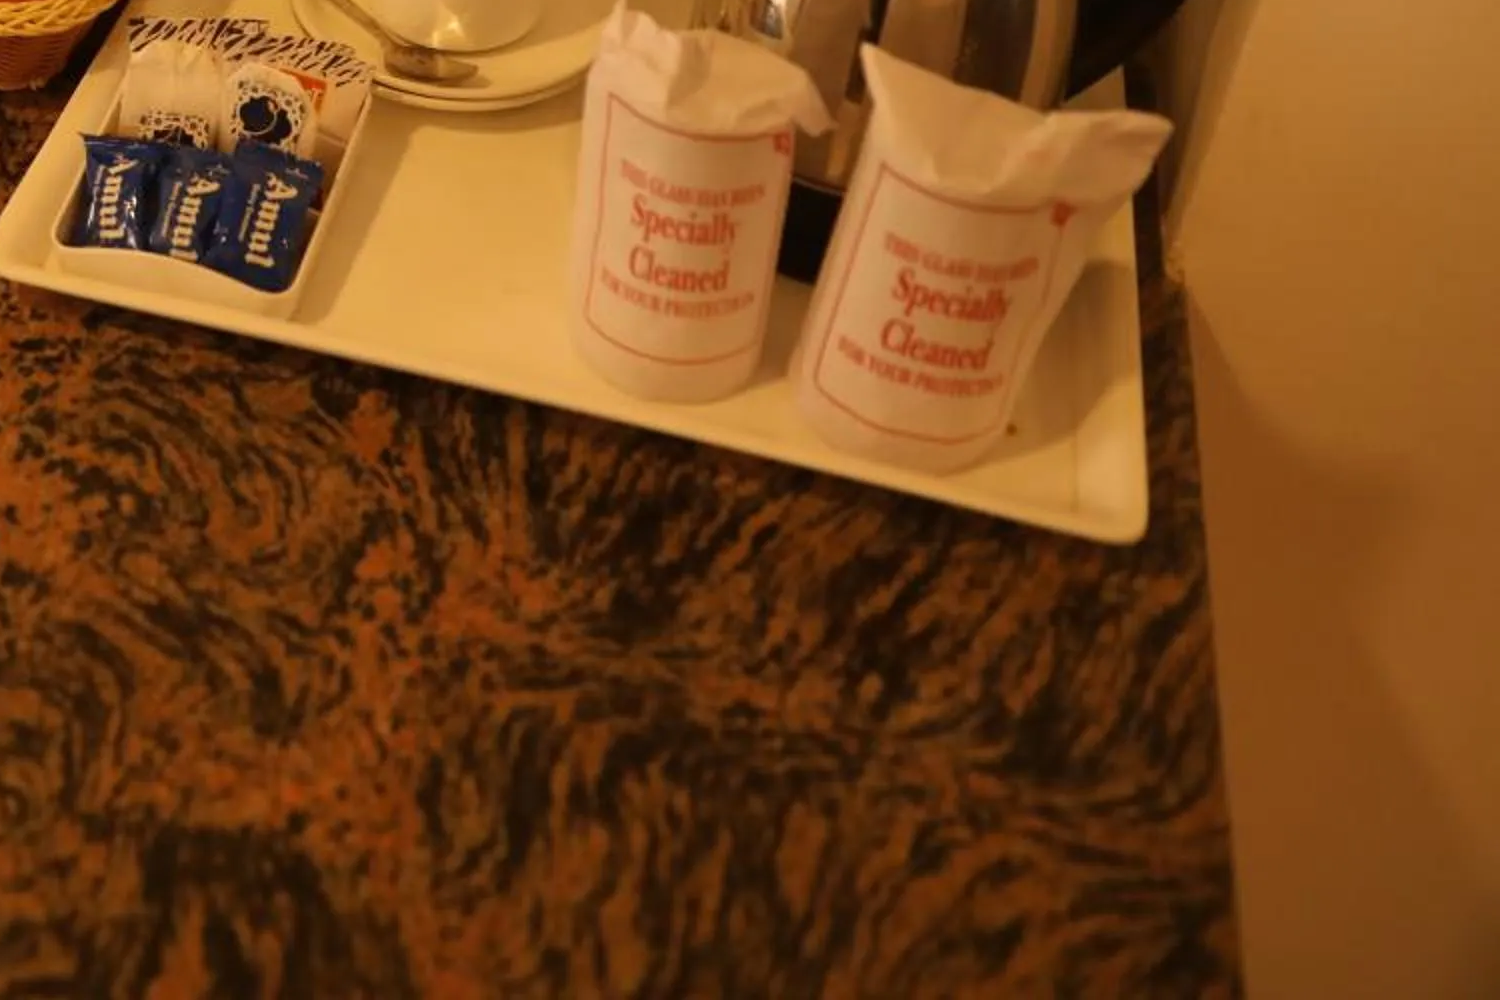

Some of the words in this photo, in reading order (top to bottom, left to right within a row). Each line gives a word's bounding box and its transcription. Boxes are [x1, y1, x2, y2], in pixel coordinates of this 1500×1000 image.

[98, 153, 139, 239] Amul
[170, 172, 221, 261] Amul
[244, 172, 298, 267] Amul
[630, 192, 741, 250] Specially
[628, 245, 731, 293] Cleaned
[891, 266, 1013, 324] Specially
[880, 317, 996, 371] Cleaned
